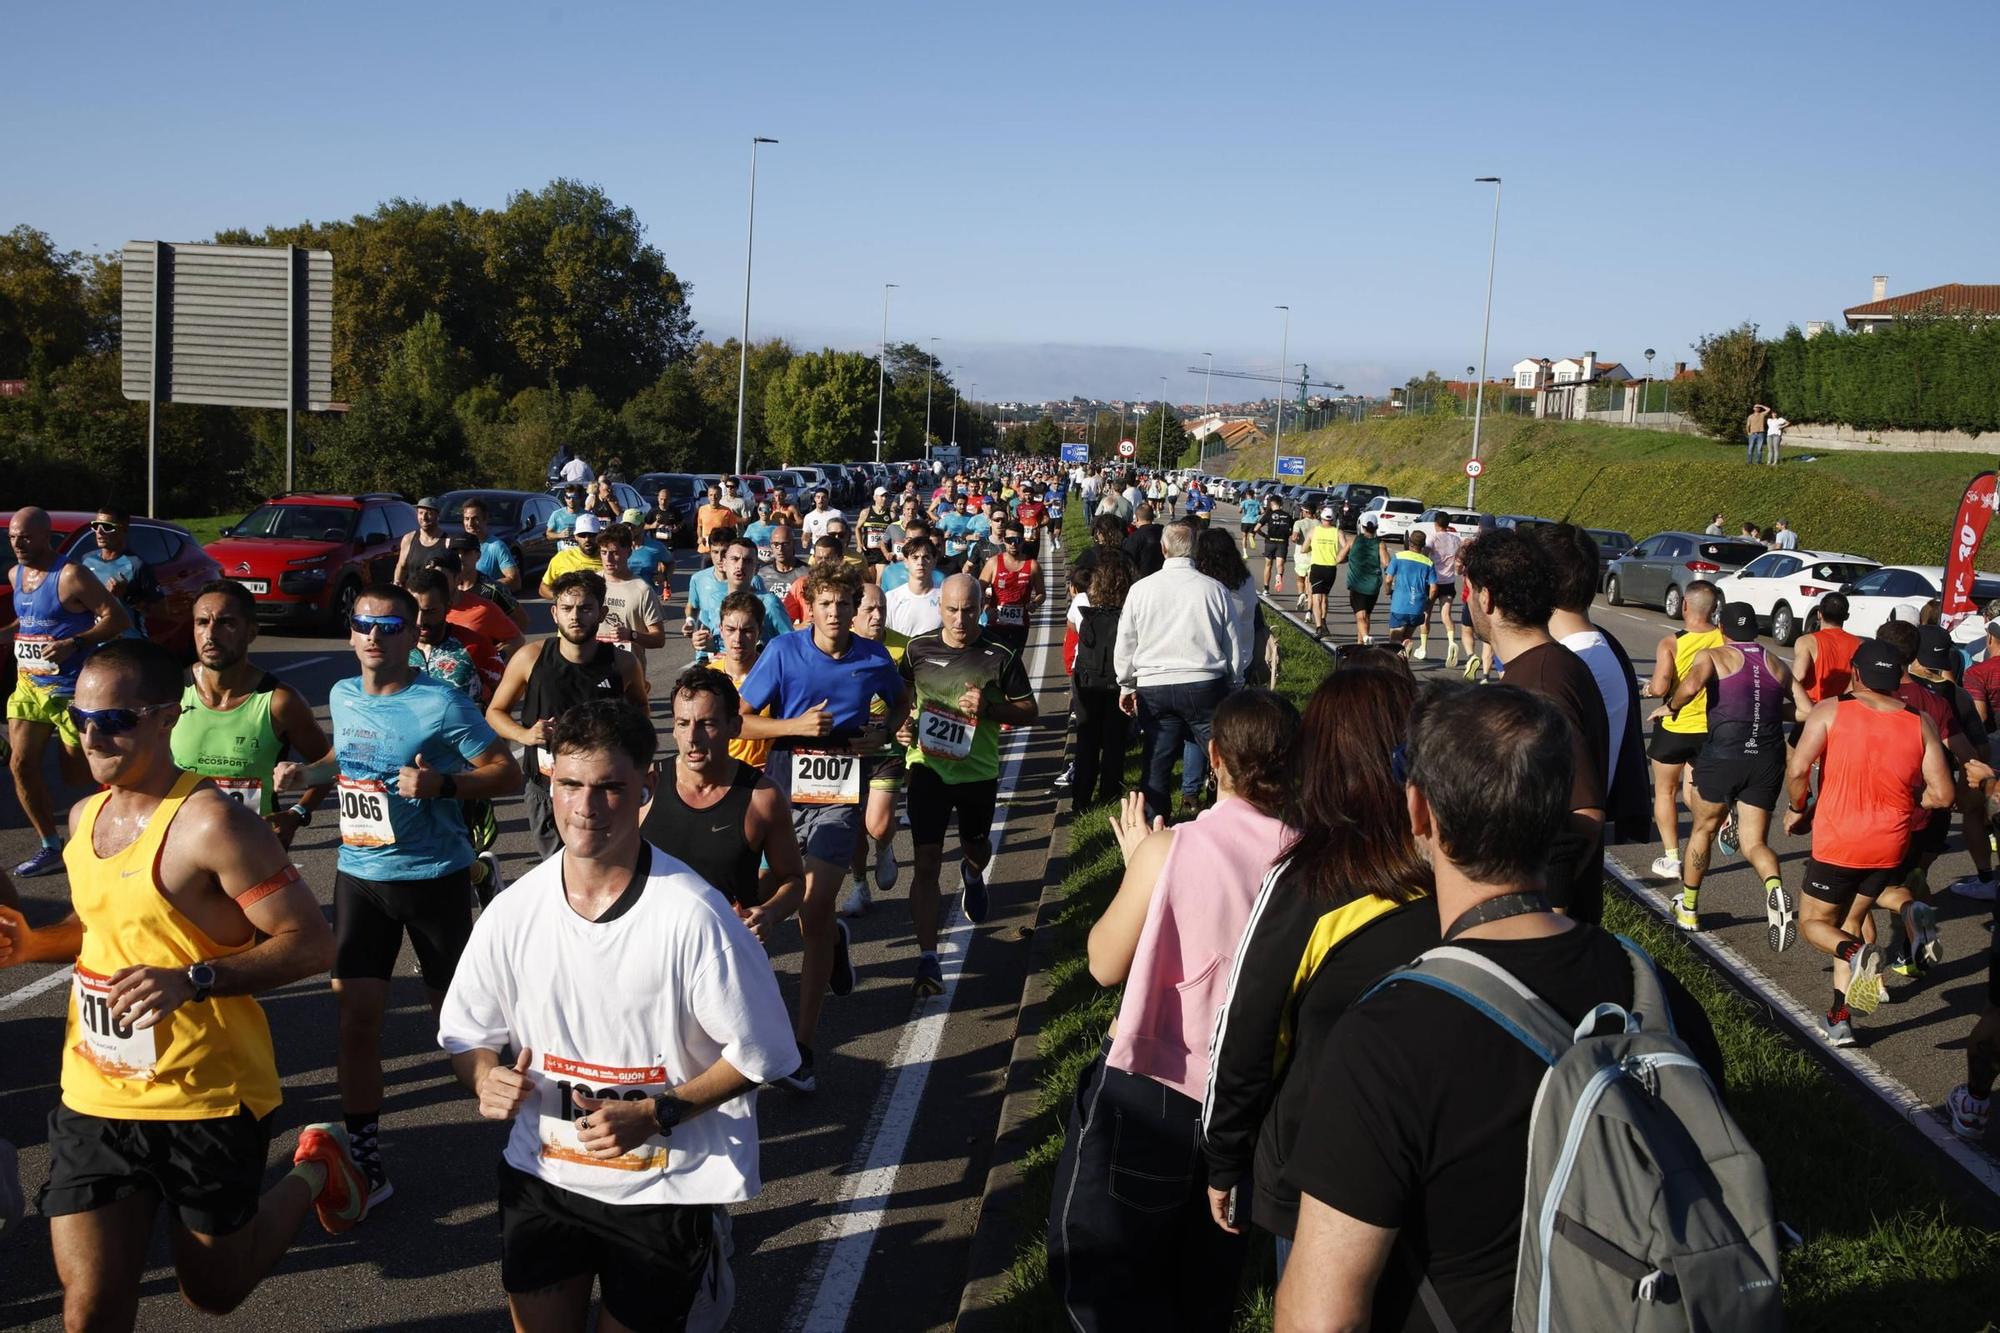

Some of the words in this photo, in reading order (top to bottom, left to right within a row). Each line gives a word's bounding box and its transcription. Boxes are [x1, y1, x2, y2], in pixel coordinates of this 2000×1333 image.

[1121, 444, 1132, 452] 50
[607, 597, 626, 608] CROSS
[925, 716, 966, 745] 2211
[798, 757, 854, 781] 2007
[576, 1066, 600, 1078] MBA
